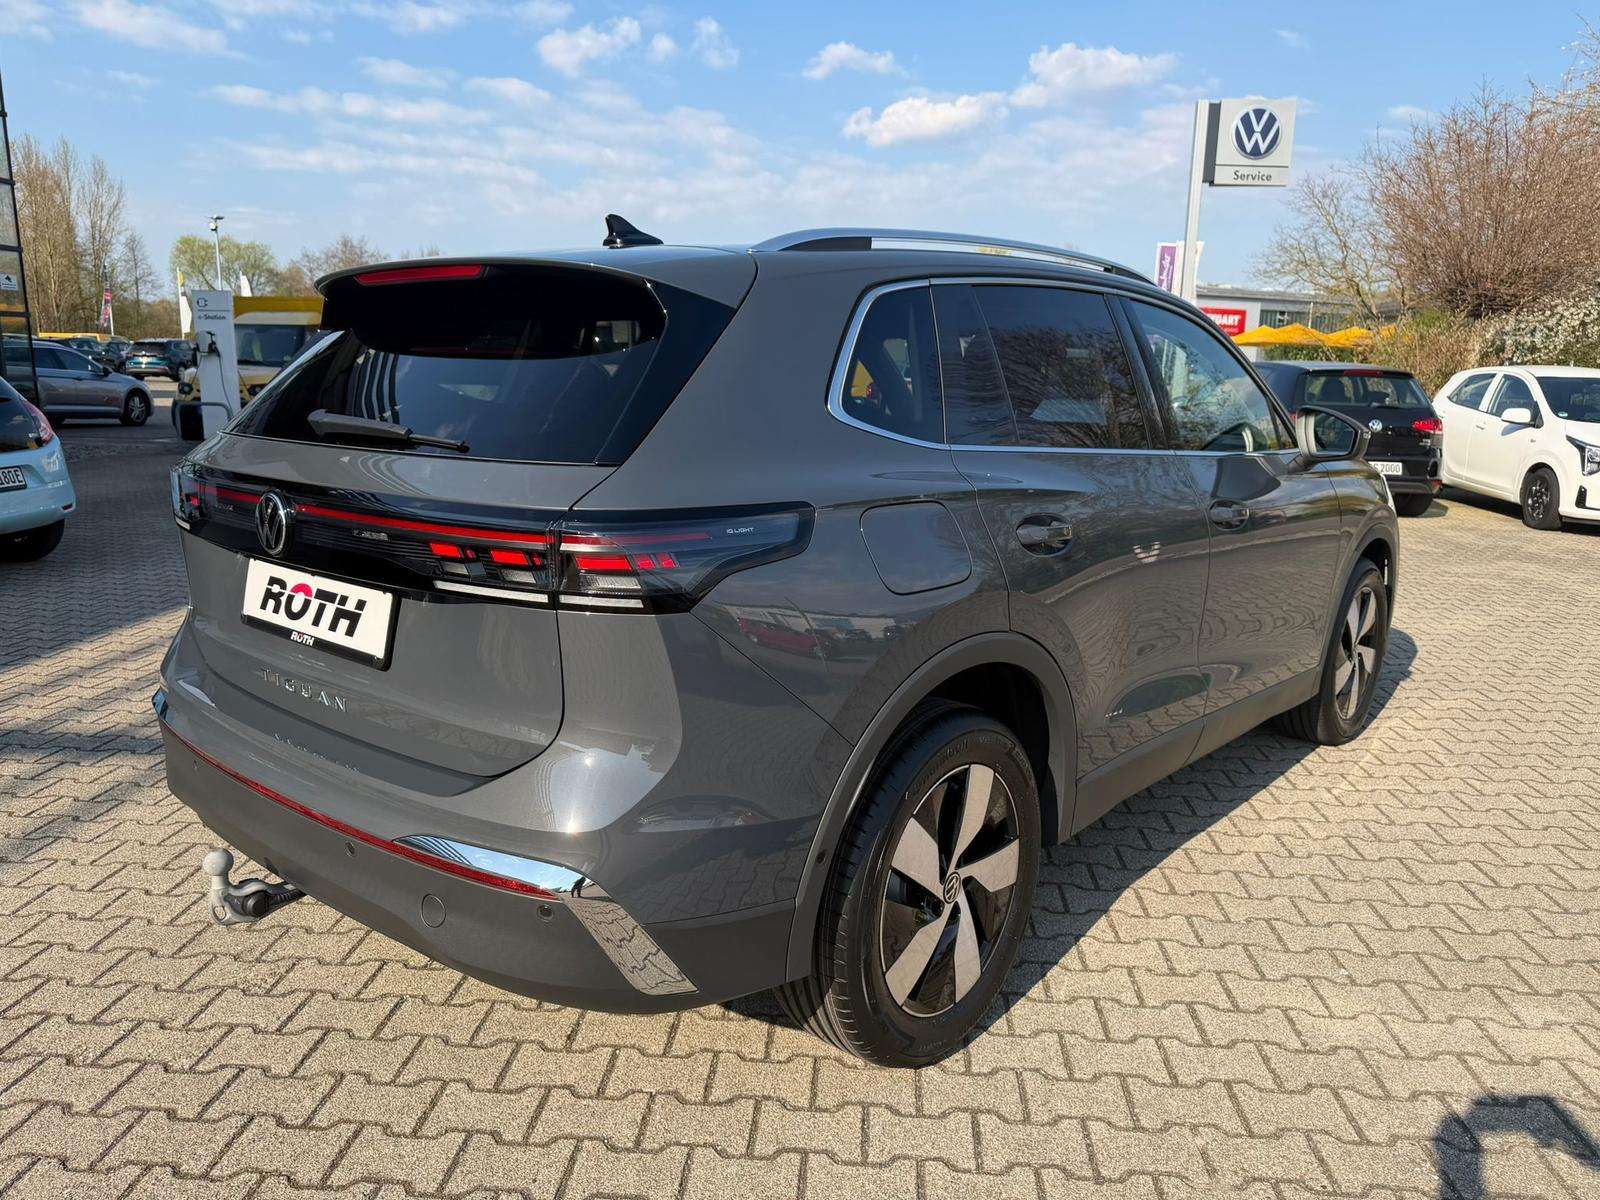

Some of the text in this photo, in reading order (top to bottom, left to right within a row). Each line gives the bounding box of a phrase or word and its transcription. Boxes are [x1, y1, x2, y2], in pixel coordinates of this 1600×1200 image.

[1232, 106, 1282, 158] VW
[1233, 170, 1272, 182] Service
[1381, 463, 1401, 473] 2000
[259, 575, 368, 638] ROTH
[290, 630, 315, 647] ROTH
[261, 668, 348, 713] TIGUAN
